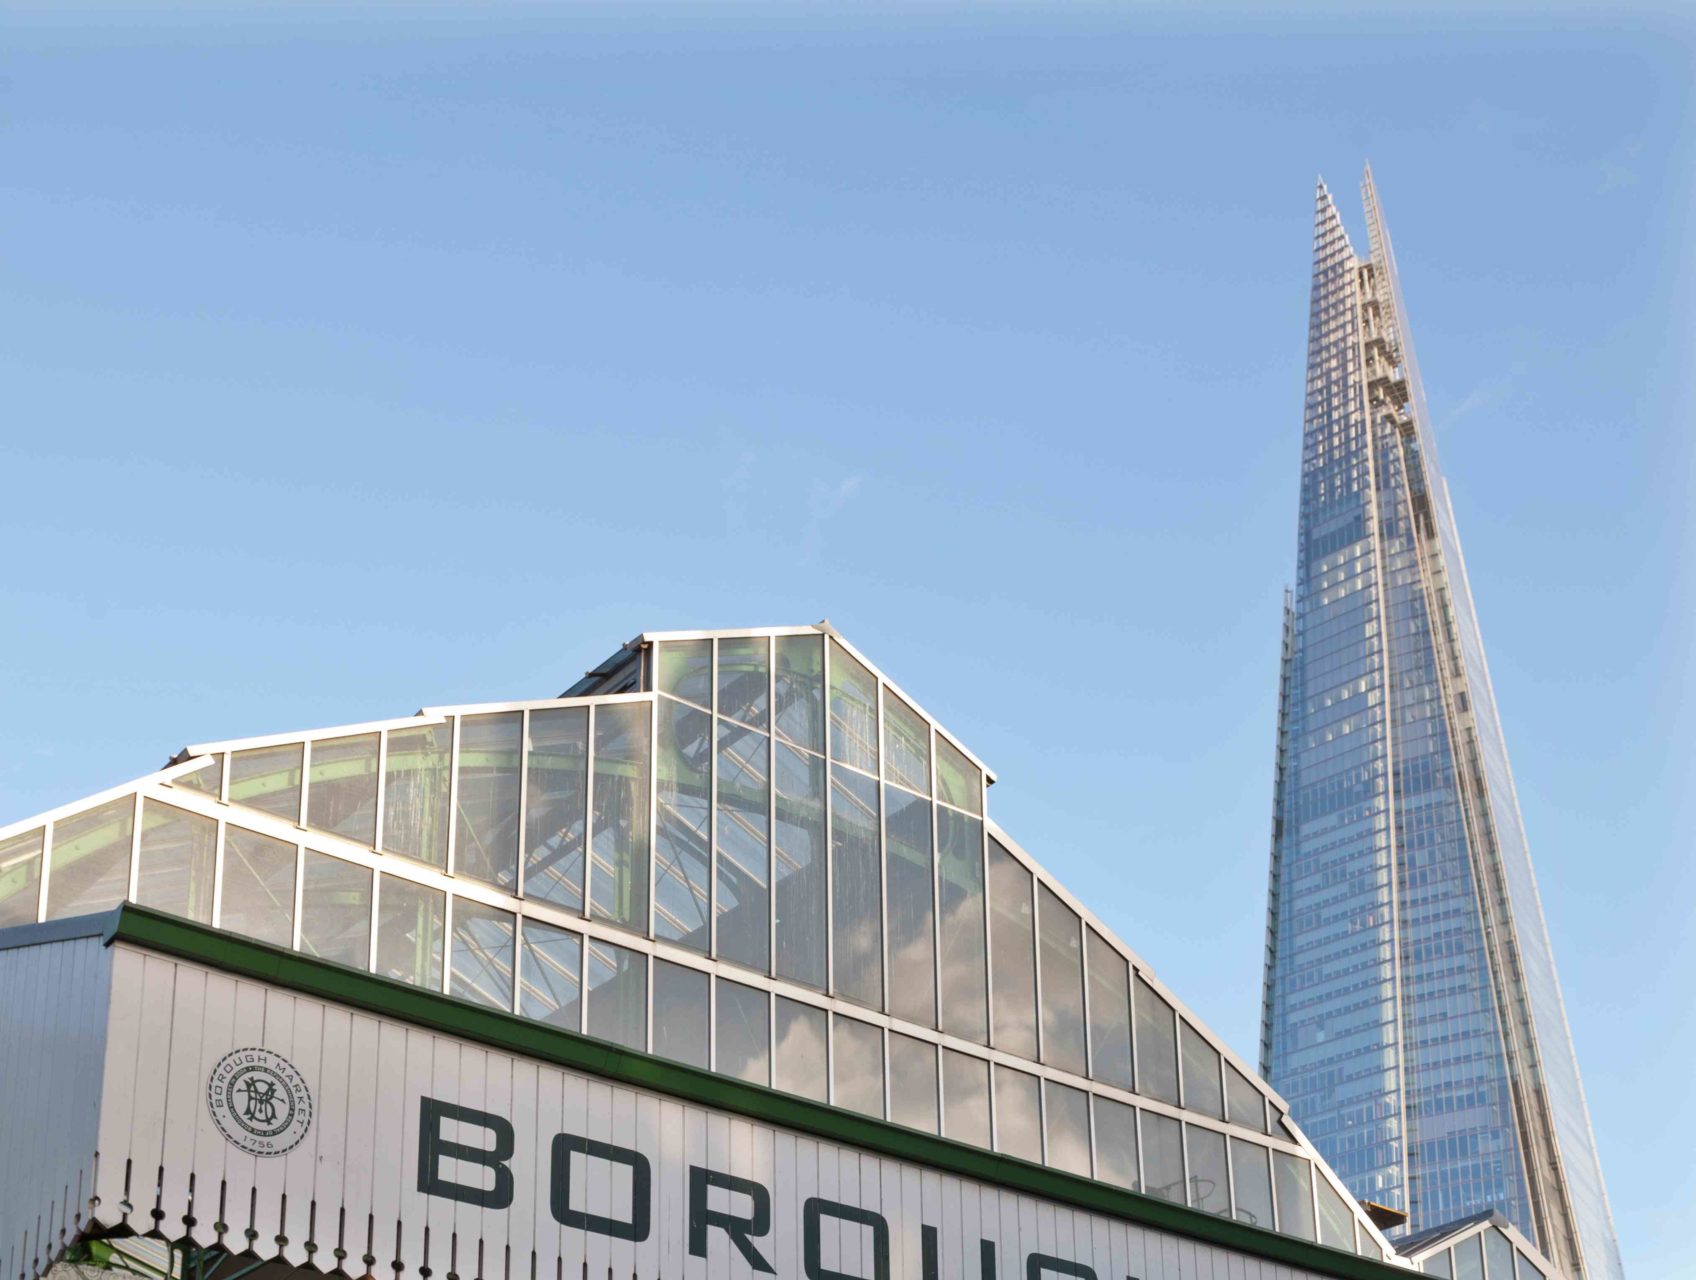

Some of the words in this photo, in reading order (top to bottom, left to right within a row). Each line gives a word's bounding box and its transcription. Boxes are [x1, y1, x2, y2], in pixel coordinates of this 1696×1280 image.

[215, 1055, 267, 1108] BOROUGH
[275, 1063, 306, 1127] MARKET
[243, 1136, 274, 1149] 1756
